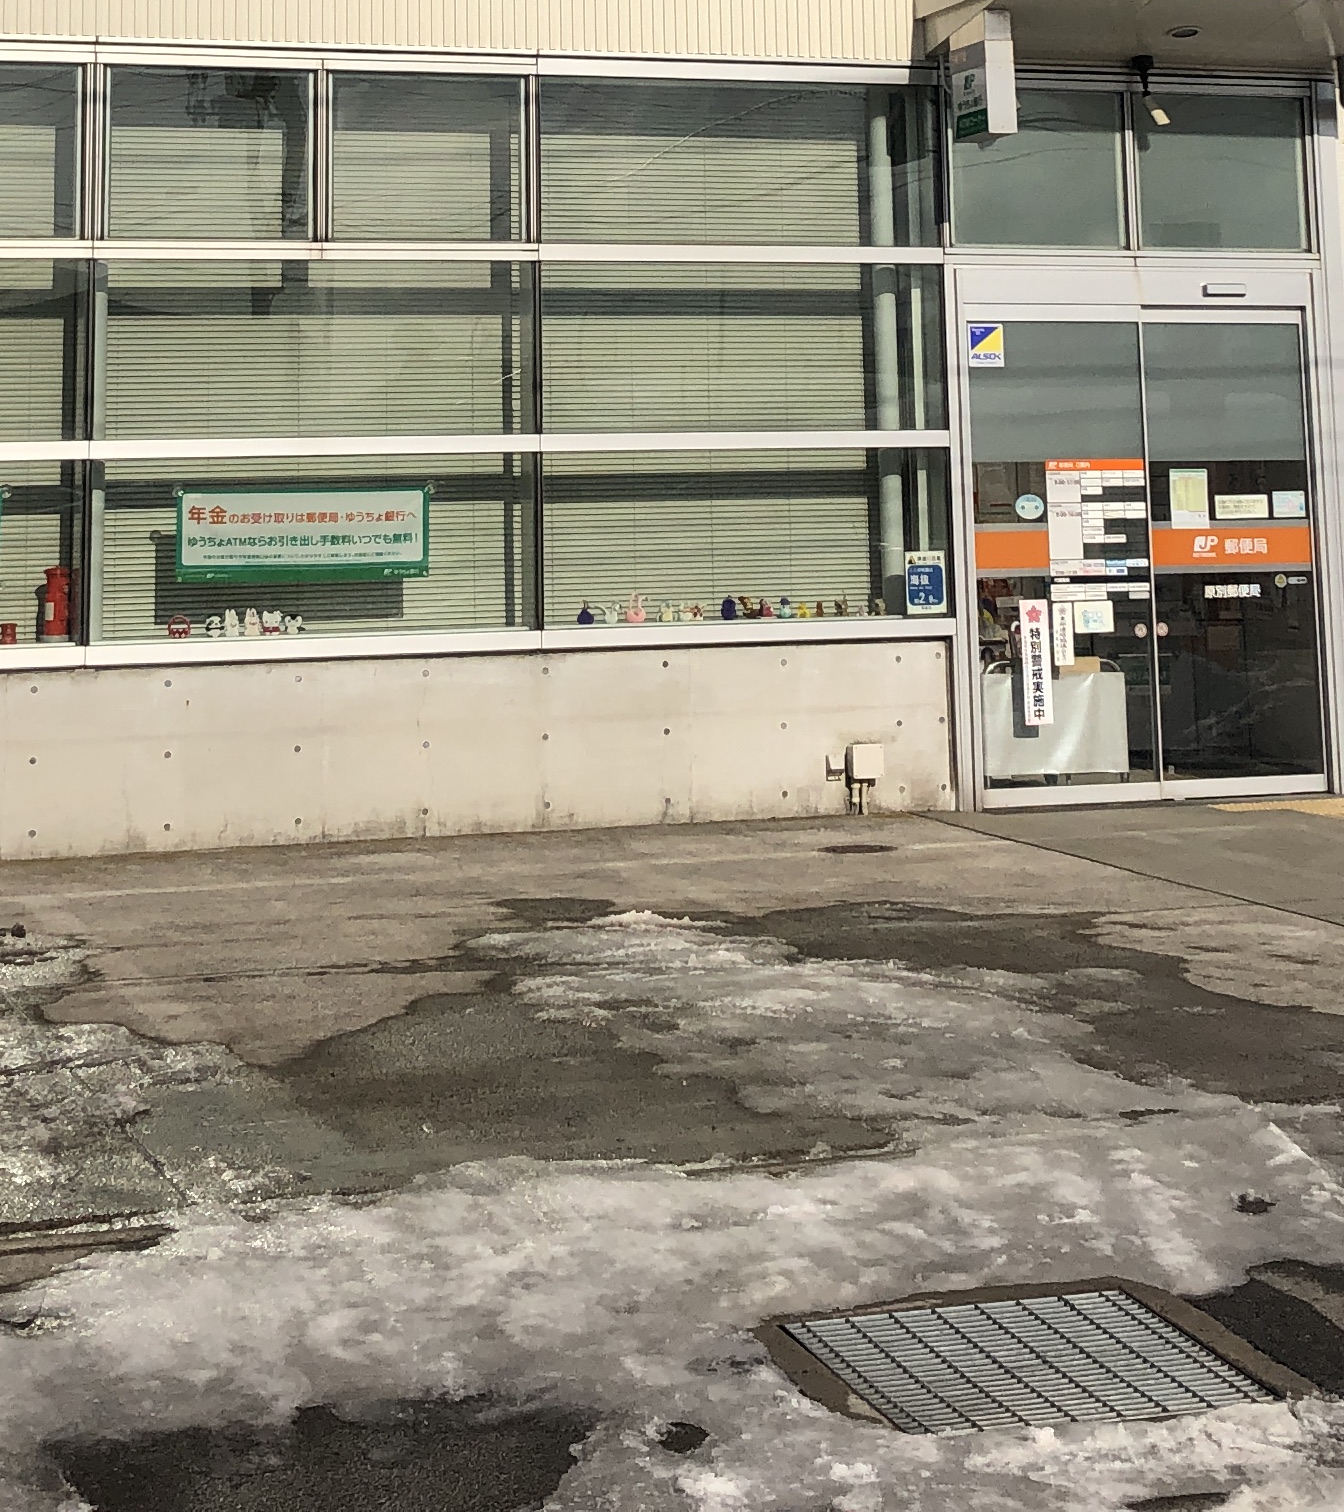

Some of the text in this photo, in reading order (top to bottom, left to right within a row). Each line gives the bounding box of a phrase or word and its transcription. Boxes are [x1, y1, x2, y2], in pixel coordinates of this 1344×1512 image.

[188, 505, 417, 525] 年金のお受け取りは郵便局・ゆうちょ銀行へ
[1224, 538, 1268, 555] 郵便局
[1029, 627, 1046, 721] 特別警戒実施中
